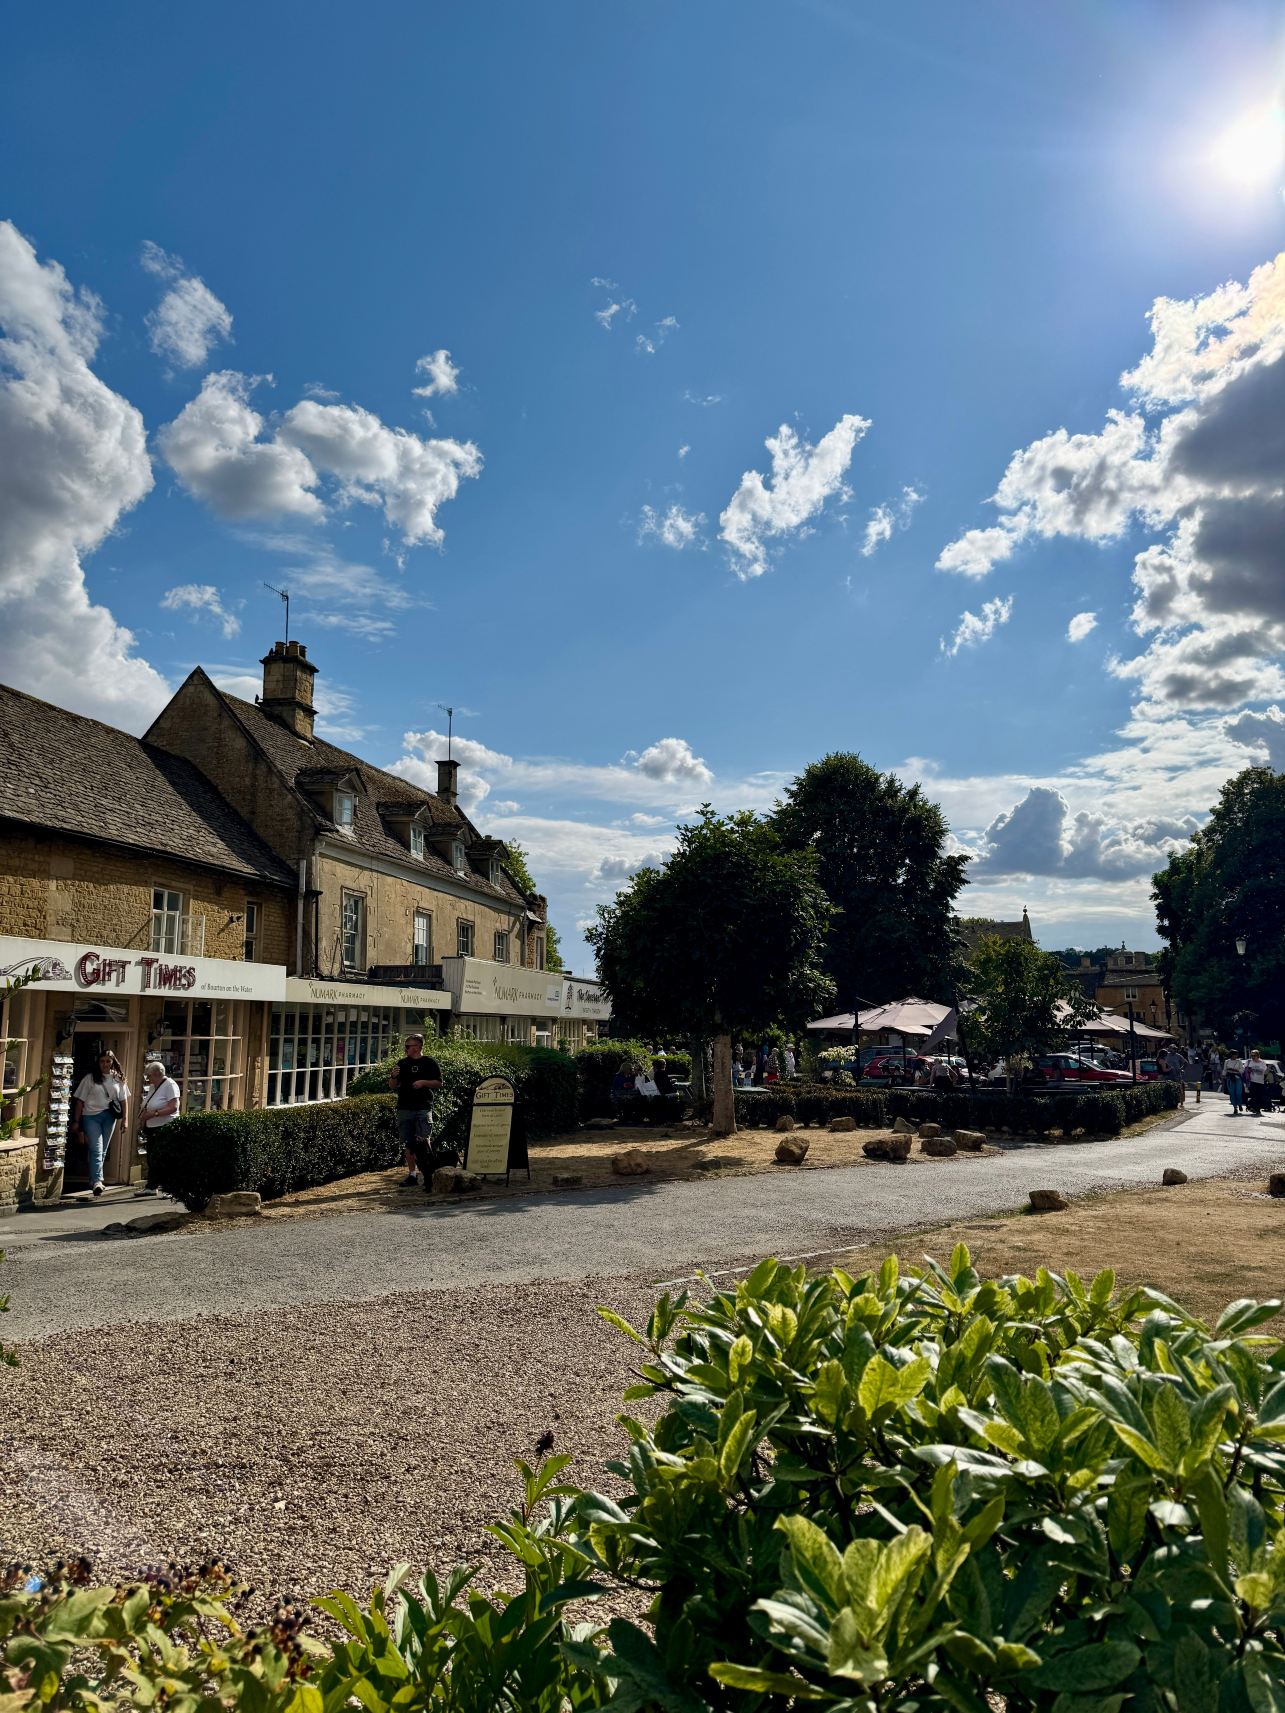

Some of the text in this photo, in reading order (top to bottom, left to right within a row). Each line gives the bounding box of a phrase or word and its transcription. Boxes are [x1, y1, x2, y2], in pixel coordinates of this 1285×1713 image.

[80, 951, 196, 989] GIFT TIMES
[310, 987, 366, 1002] NUMARK PHARMACY
[400, 994, 420, 1006] NUMARK
[494, 985, 543, 1003] NUMARK PHARMACY
[475, 1091, 492, 1100] GIFT
[494, 1091, 514, 1099] TIMES
